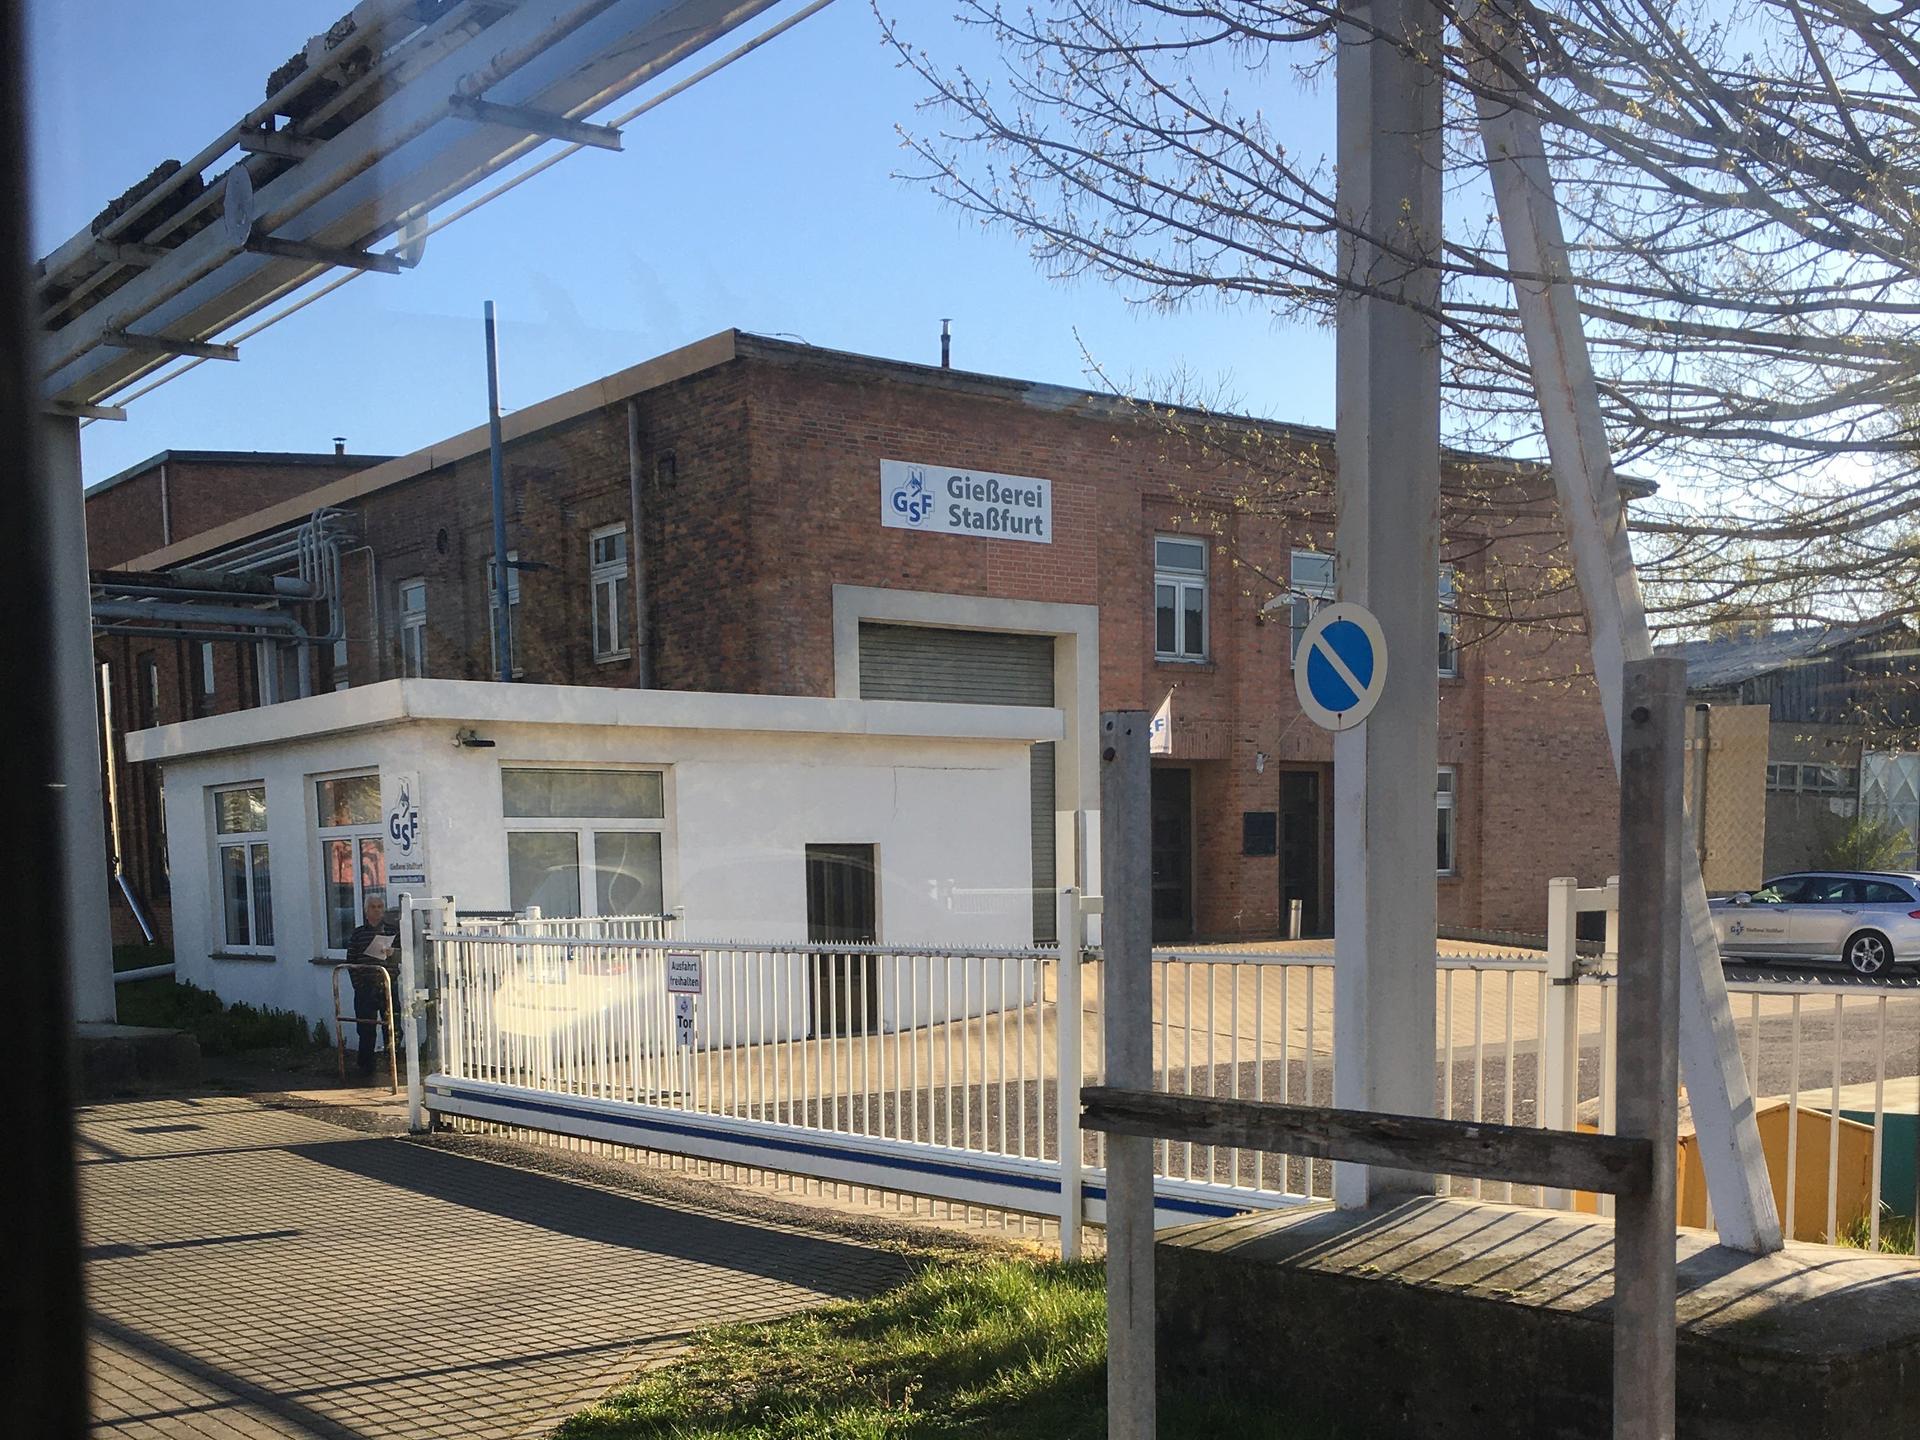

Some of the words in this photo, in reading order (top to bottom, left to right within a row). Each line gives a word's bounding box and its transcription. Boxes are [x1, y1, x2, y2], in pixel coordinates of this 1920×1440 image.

[947, 475, 1043, 508] Gießerei
[893, 491, 932, 522] GSF
[948, 503, 1043, 536] Staßfurt
[390, 812, 418, 851] GSF
[671, 961, 697, 972] Ausfahrt
[669, 975, 699, 987] freihalten
[677, 1015, 693, 1029] Tor
[683, 1031, 688, 1045] 1
